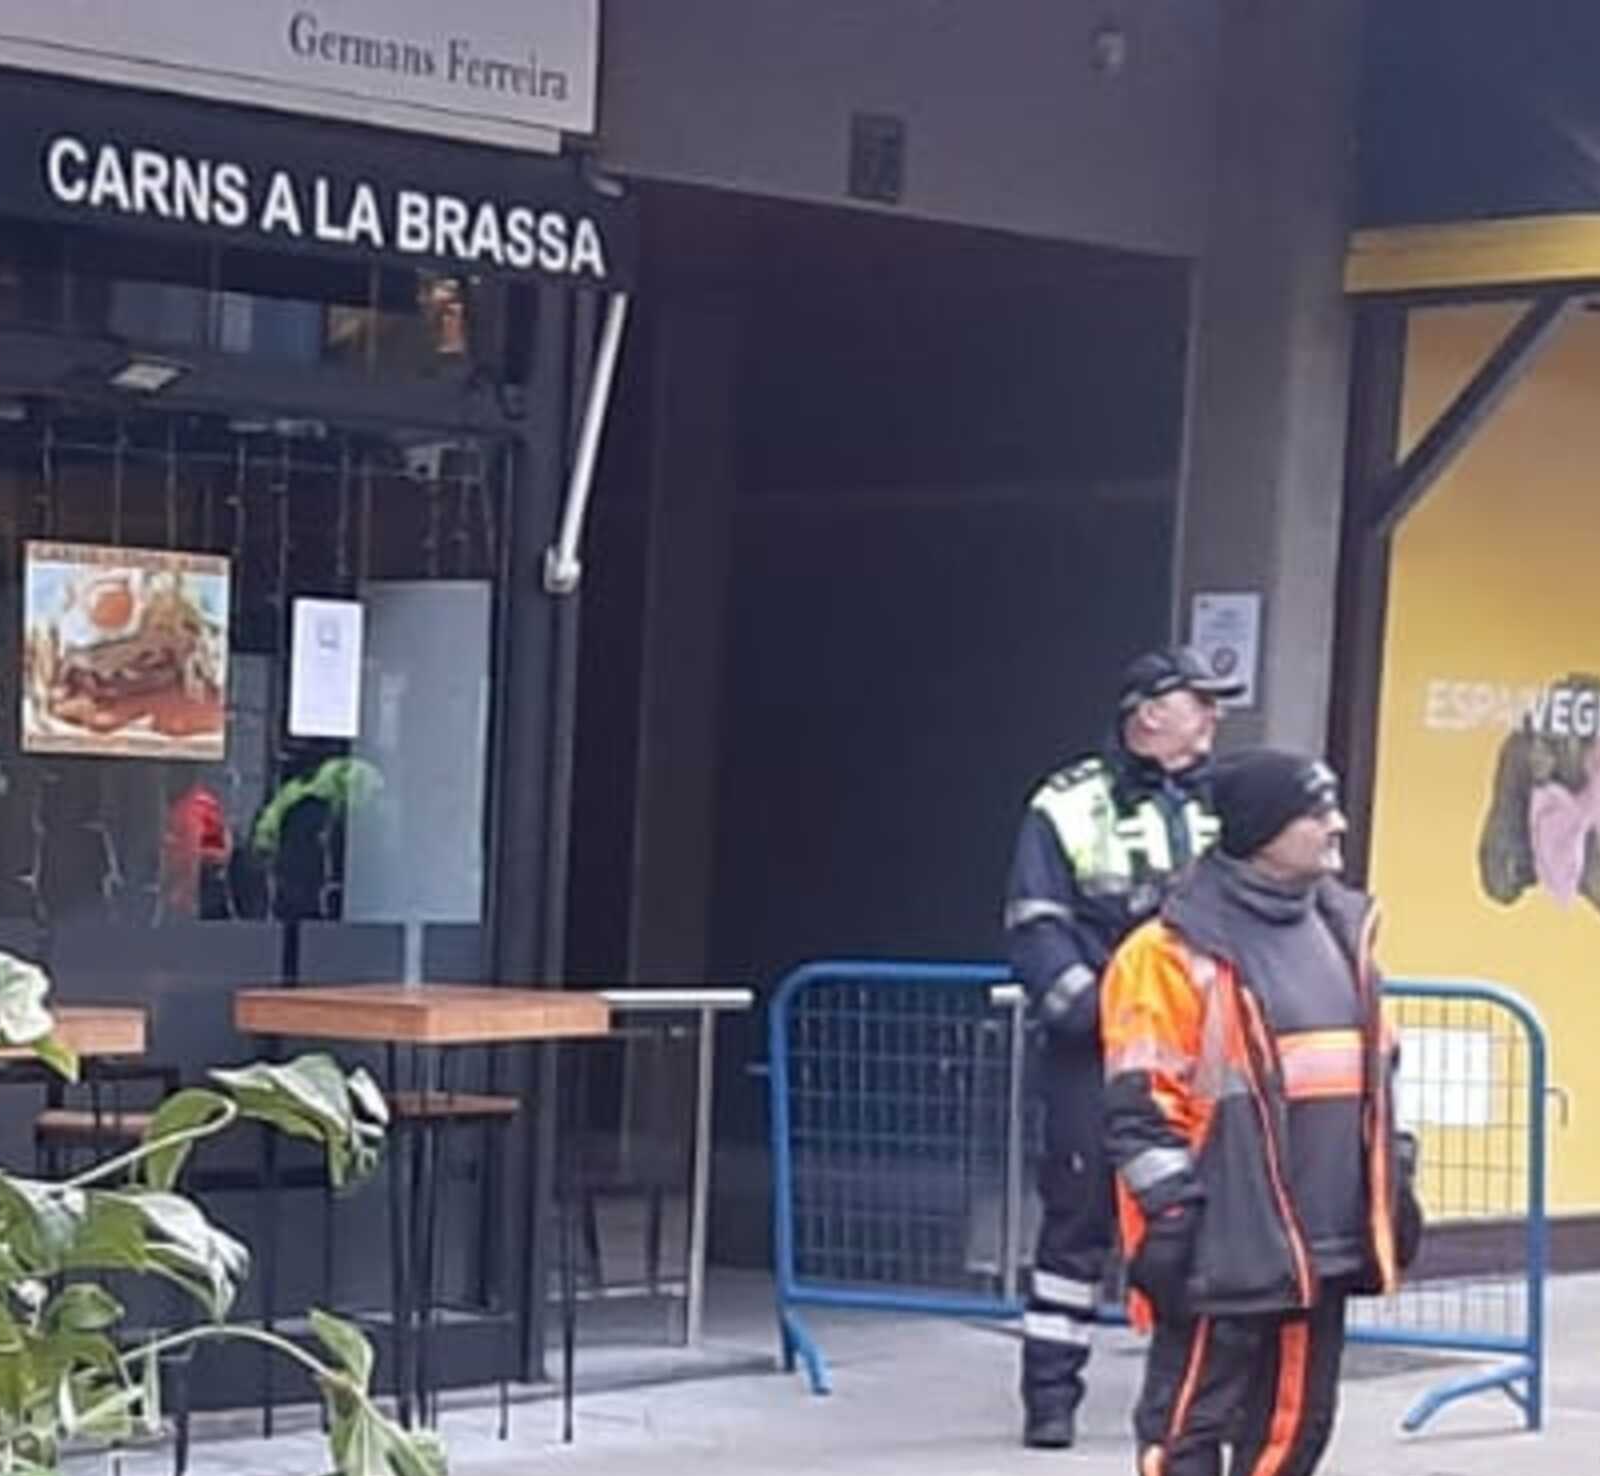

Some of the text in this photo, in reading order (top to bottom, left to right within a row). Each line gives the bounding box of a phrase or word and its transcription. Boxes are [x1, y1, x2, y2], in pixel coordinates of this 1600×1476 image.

[287, 9, 570, 102] Germans Ferreira
[47, 136, 605, 279] CARNS A LA BRASSA
